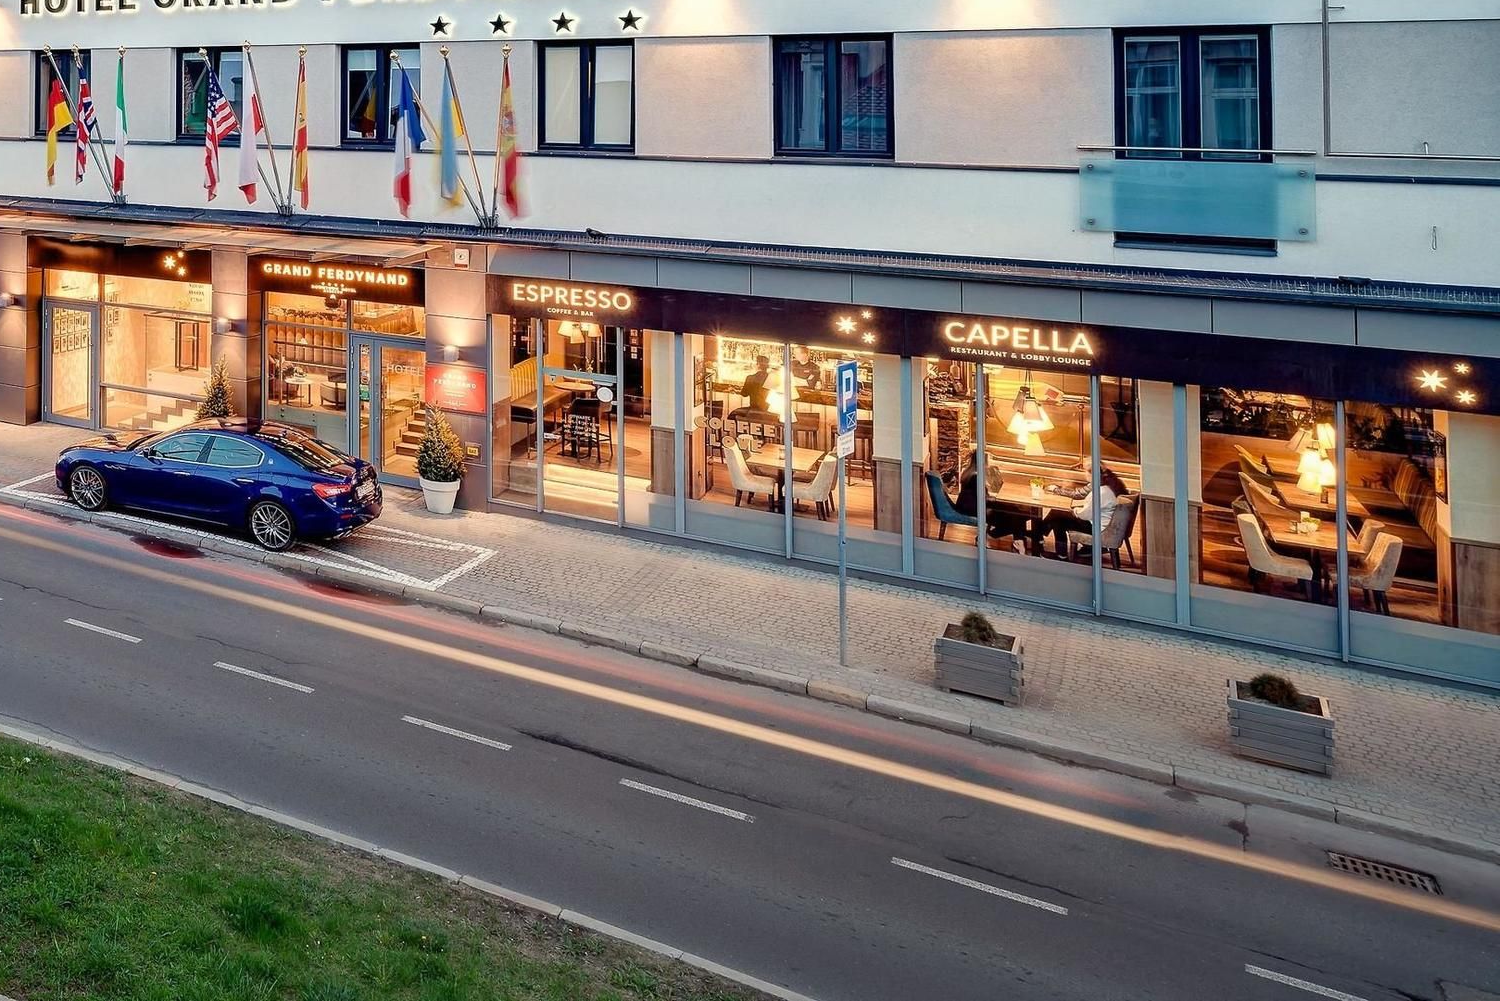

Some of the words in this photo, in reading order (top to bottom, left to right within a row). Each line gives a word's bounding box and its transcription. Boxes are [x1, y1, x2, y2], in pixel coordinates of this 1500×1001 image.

[263, 263, 312, 277] GRAND
[318, 267, 408, 286] FERDYNAND
[513, 283, 632, 311] ESPRESSO
[546, 307, 572, 315] COFFEE
[944, 321, 1094, 355] CAPELLA
[950, 346, 1008, 358] RESTAURANT
[1020, 353, 1051, 363] LOBBY
[1052, 356, 1092, 367] LOUNGE
[386, 363, 424, 376] HOTEL
[842, 369, 854, 413] P
[694, 415, 776, 438] COFFEE
